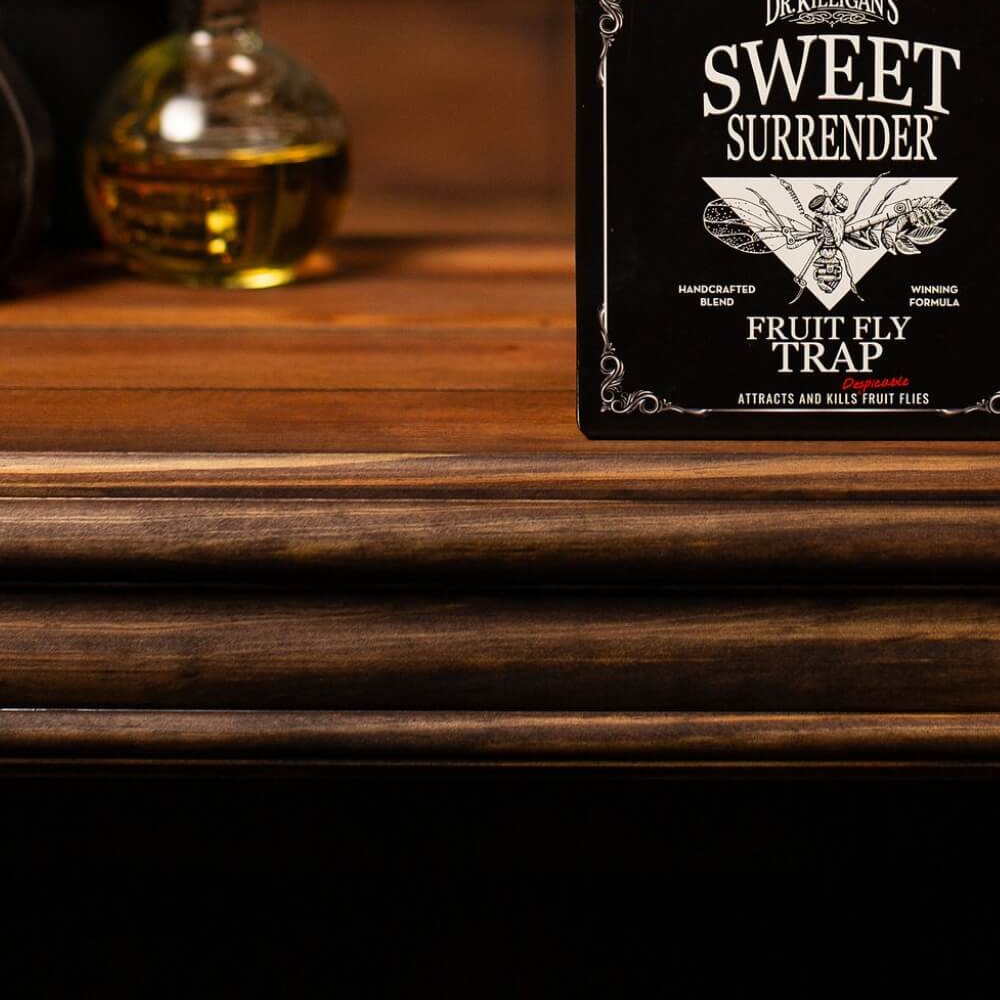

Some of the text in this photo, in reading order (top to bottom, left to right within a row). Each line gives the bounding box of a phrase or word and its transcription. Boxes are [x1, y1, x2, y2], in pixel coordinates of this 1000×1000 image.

[703, 35, 961, 117] SWEET
[727, 114, 938, 161] SURRENDER
[678, 285, 756, 294] HANDCRAFTED
[910, 285, 959, 294] WINNING
[700, 297, 735, 307] BLEND
[909, 298, 960, 307] FORMULA
[746, 316, 912, 340] FRUIT FLY
[772, 341, 883, 373] TRAP
[738, 393, 929, 405] ATTRACTS AND KILLS FRUIT FLIES
